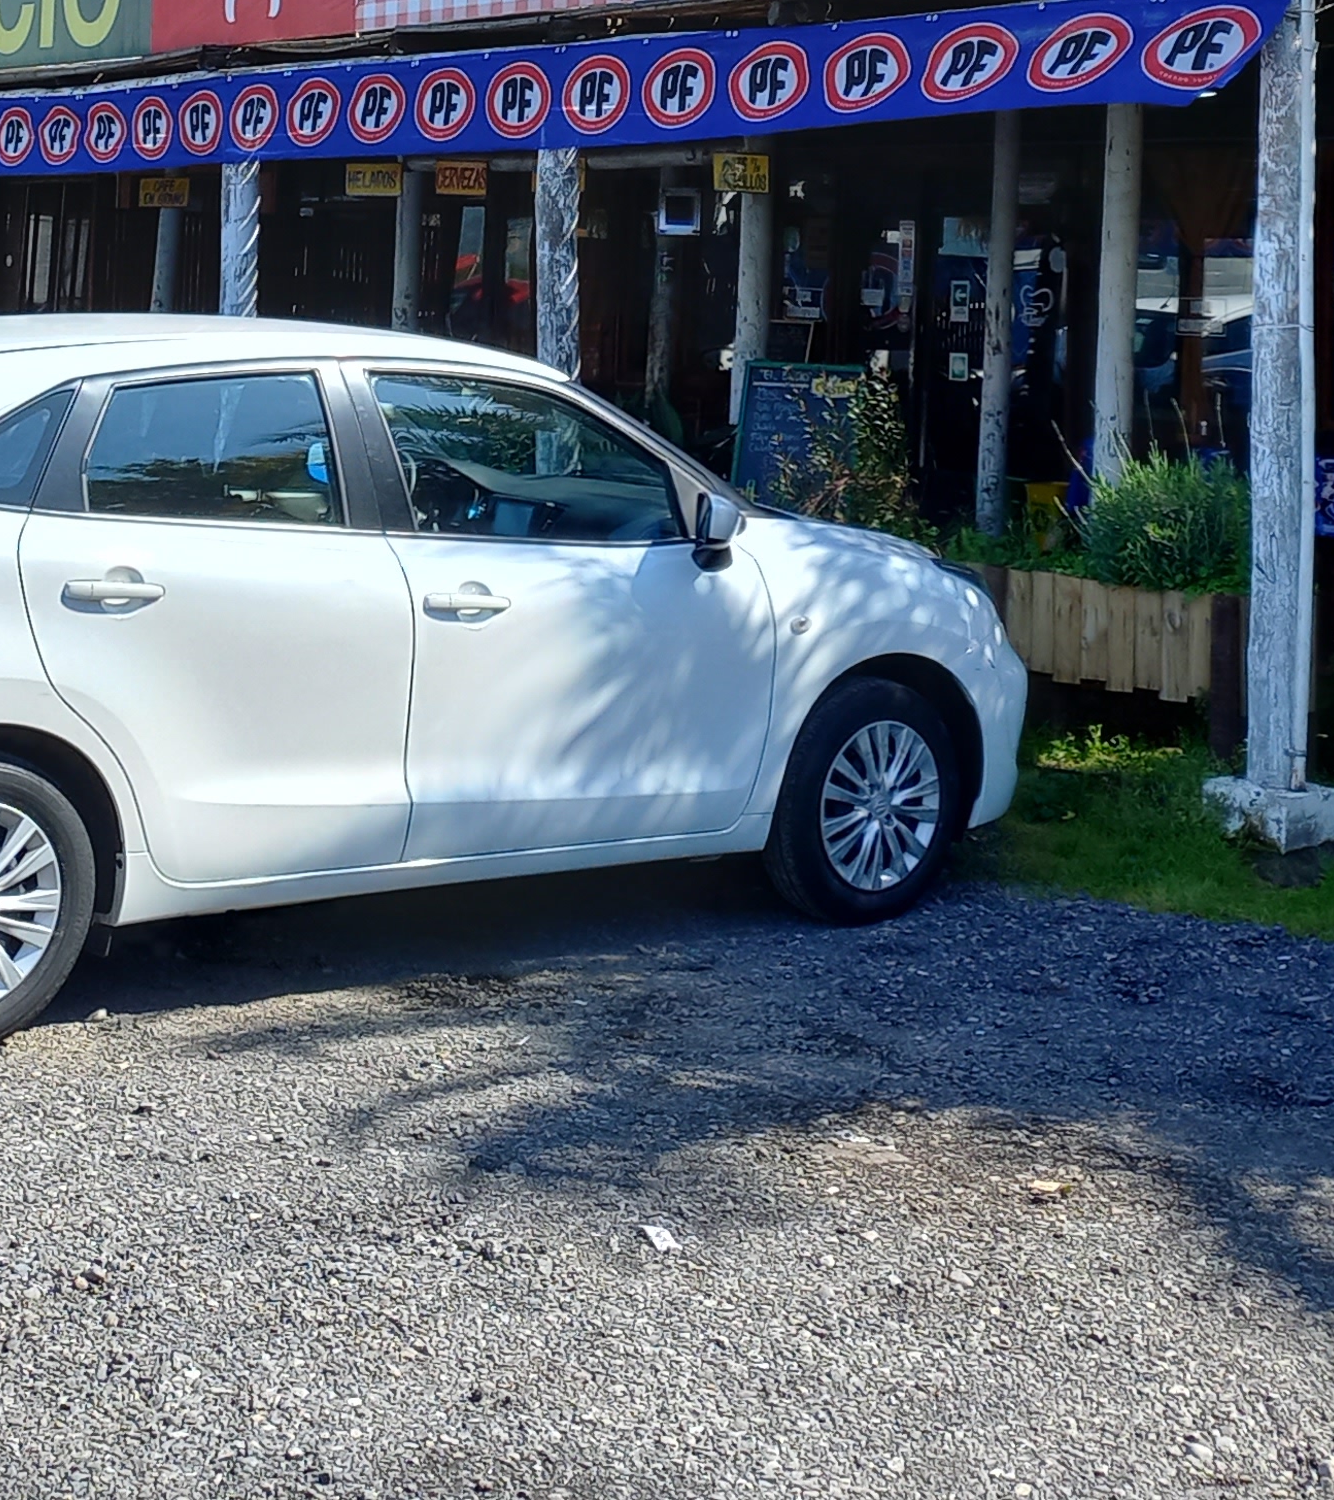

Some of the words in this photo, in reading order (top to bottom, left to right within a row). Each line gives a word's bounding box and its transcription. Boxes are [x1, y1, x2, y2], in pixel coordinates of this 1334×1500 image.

[943, 40, 998, 87] PF
[1048, 31, 1110, 75] PF
[1164, 20, 1234, 70] PF
[660, 64, 698, 111] PF
[749, 56, 789, 106] PF
[844, 47, 887, 96] PF
[300, 91, 328, 134] PF
[361, 85, 391, 128] PF
[428, 82, 460, 124] PF
[502, 77, 533, 123] PF
[579, 71, 613, 117] PF
[5, 118, 23, 154] PF
[50, 117, 70, 151] PF
[96, 114, 116, 150] PF
[142, 109, 162, 146] PF
[189, 104, 211, 143] PF
[242, 97, 265, 137] PF
[348, 169, 398, 189] HELADOS
[437, 163, 487, 188] CERVEZAS
